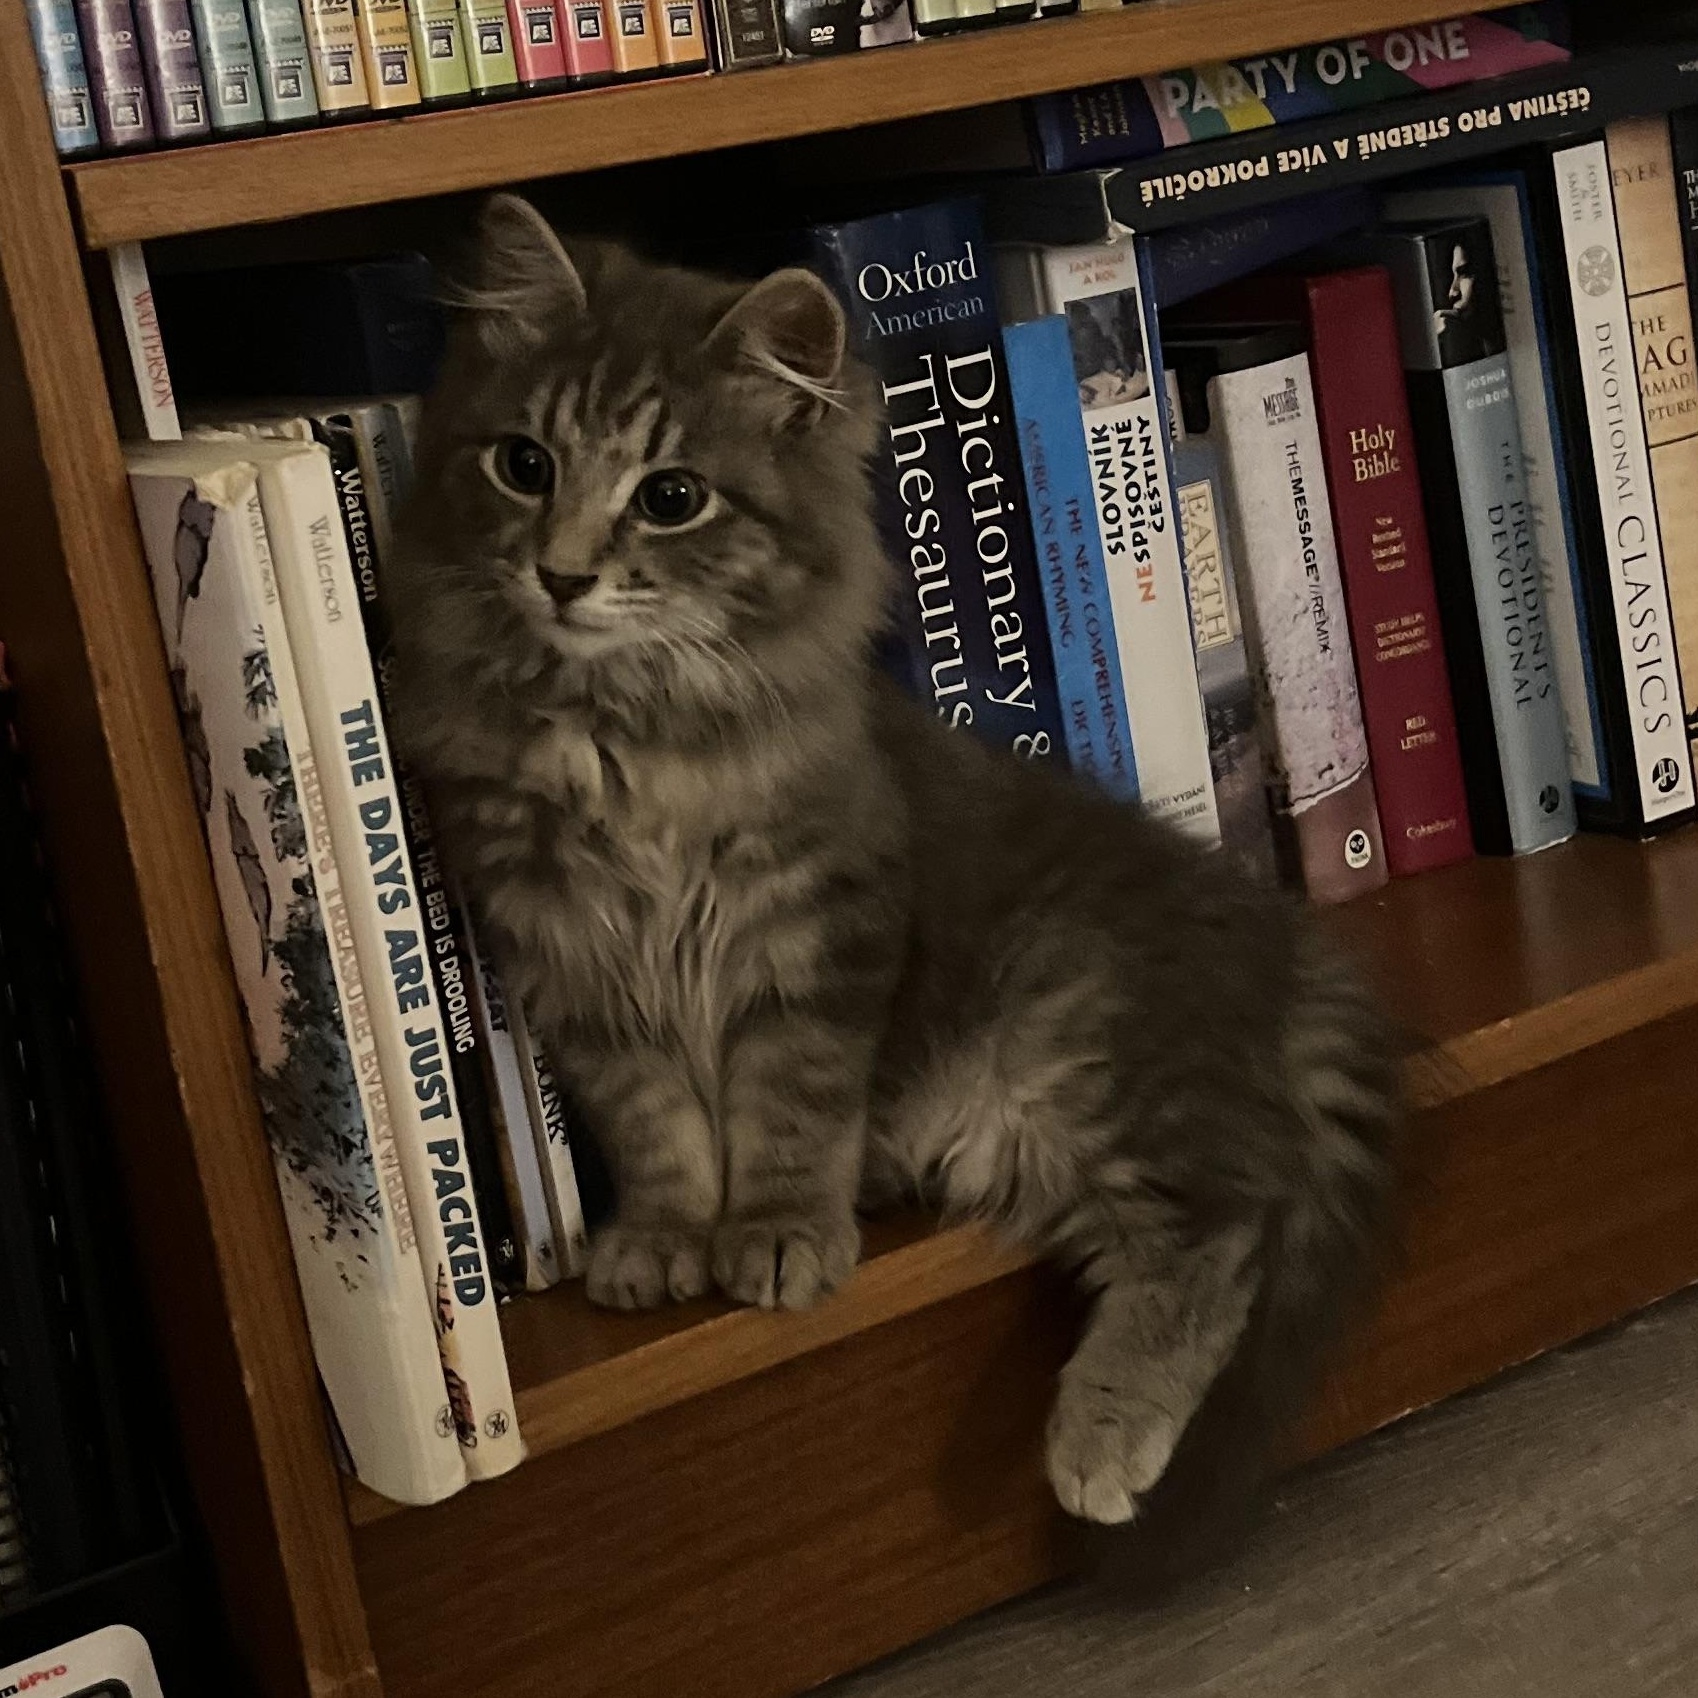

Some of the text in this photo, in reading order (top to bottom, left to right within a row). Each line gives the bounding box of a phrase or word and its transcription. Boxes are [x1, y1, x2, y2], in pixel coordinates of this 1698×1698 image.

[810, 25, 834, 37] DVD
[1164, 53, 1298, 118] PARTY
[1314, 40, 1371, 86] OF
[1383, 20, 1471, 72] ONE
[1140, 86, 1591, 206] ČEŠTINA PRO STŘEDNĚ A VÍCE POKROČILÉ
[858, 241, 978, 302] Oxford
[866, 296, 985, 340] American
[133, 289, 173, 408] WATTERSON
[1632, 316, 1667, 336] HE
[1085, 423, 1126, 555] SLOVNÍK
[1134, 414, 1166, 534] ČEŠTINY
[1349, 423, 1395, 454] Holy
[1352, 451, 1400, 483] Bible
[306, 516, 345, 623] Watterson
[341, 468, 382, 602] Watterson
[878, 354, 980, 732] Thesaurus
[943, 344, 1052, 761] Dictionary &
[1186, 491, 1228, 641] EARTH
[1593, 323, 1635, 505] DEVOTIONAL
[1615, 518, 1672, 735] CLASSICS
[1044, 542, 1076, 649] RHYMING
[1487, 505, 1533, 712] DEVOTIONAL
[338, 699, 386, 787] THE
[359, 797, 412, 916] DAYS
[416, 846, 442, 887] THE
[424, 890, 452, 931] BED
[434, 934, 456, 955] IS
[384, 926, 430, 1014] ARE
[438, 957, 476, 1054] DROOLING
[322, 887, 374, 1042] TREASURE
[357, 1051, 418, 1255] EVERYWHERE
[403, 1024, 452, 1124] JUST
[426, 1138, 488, 1308] PACKED
